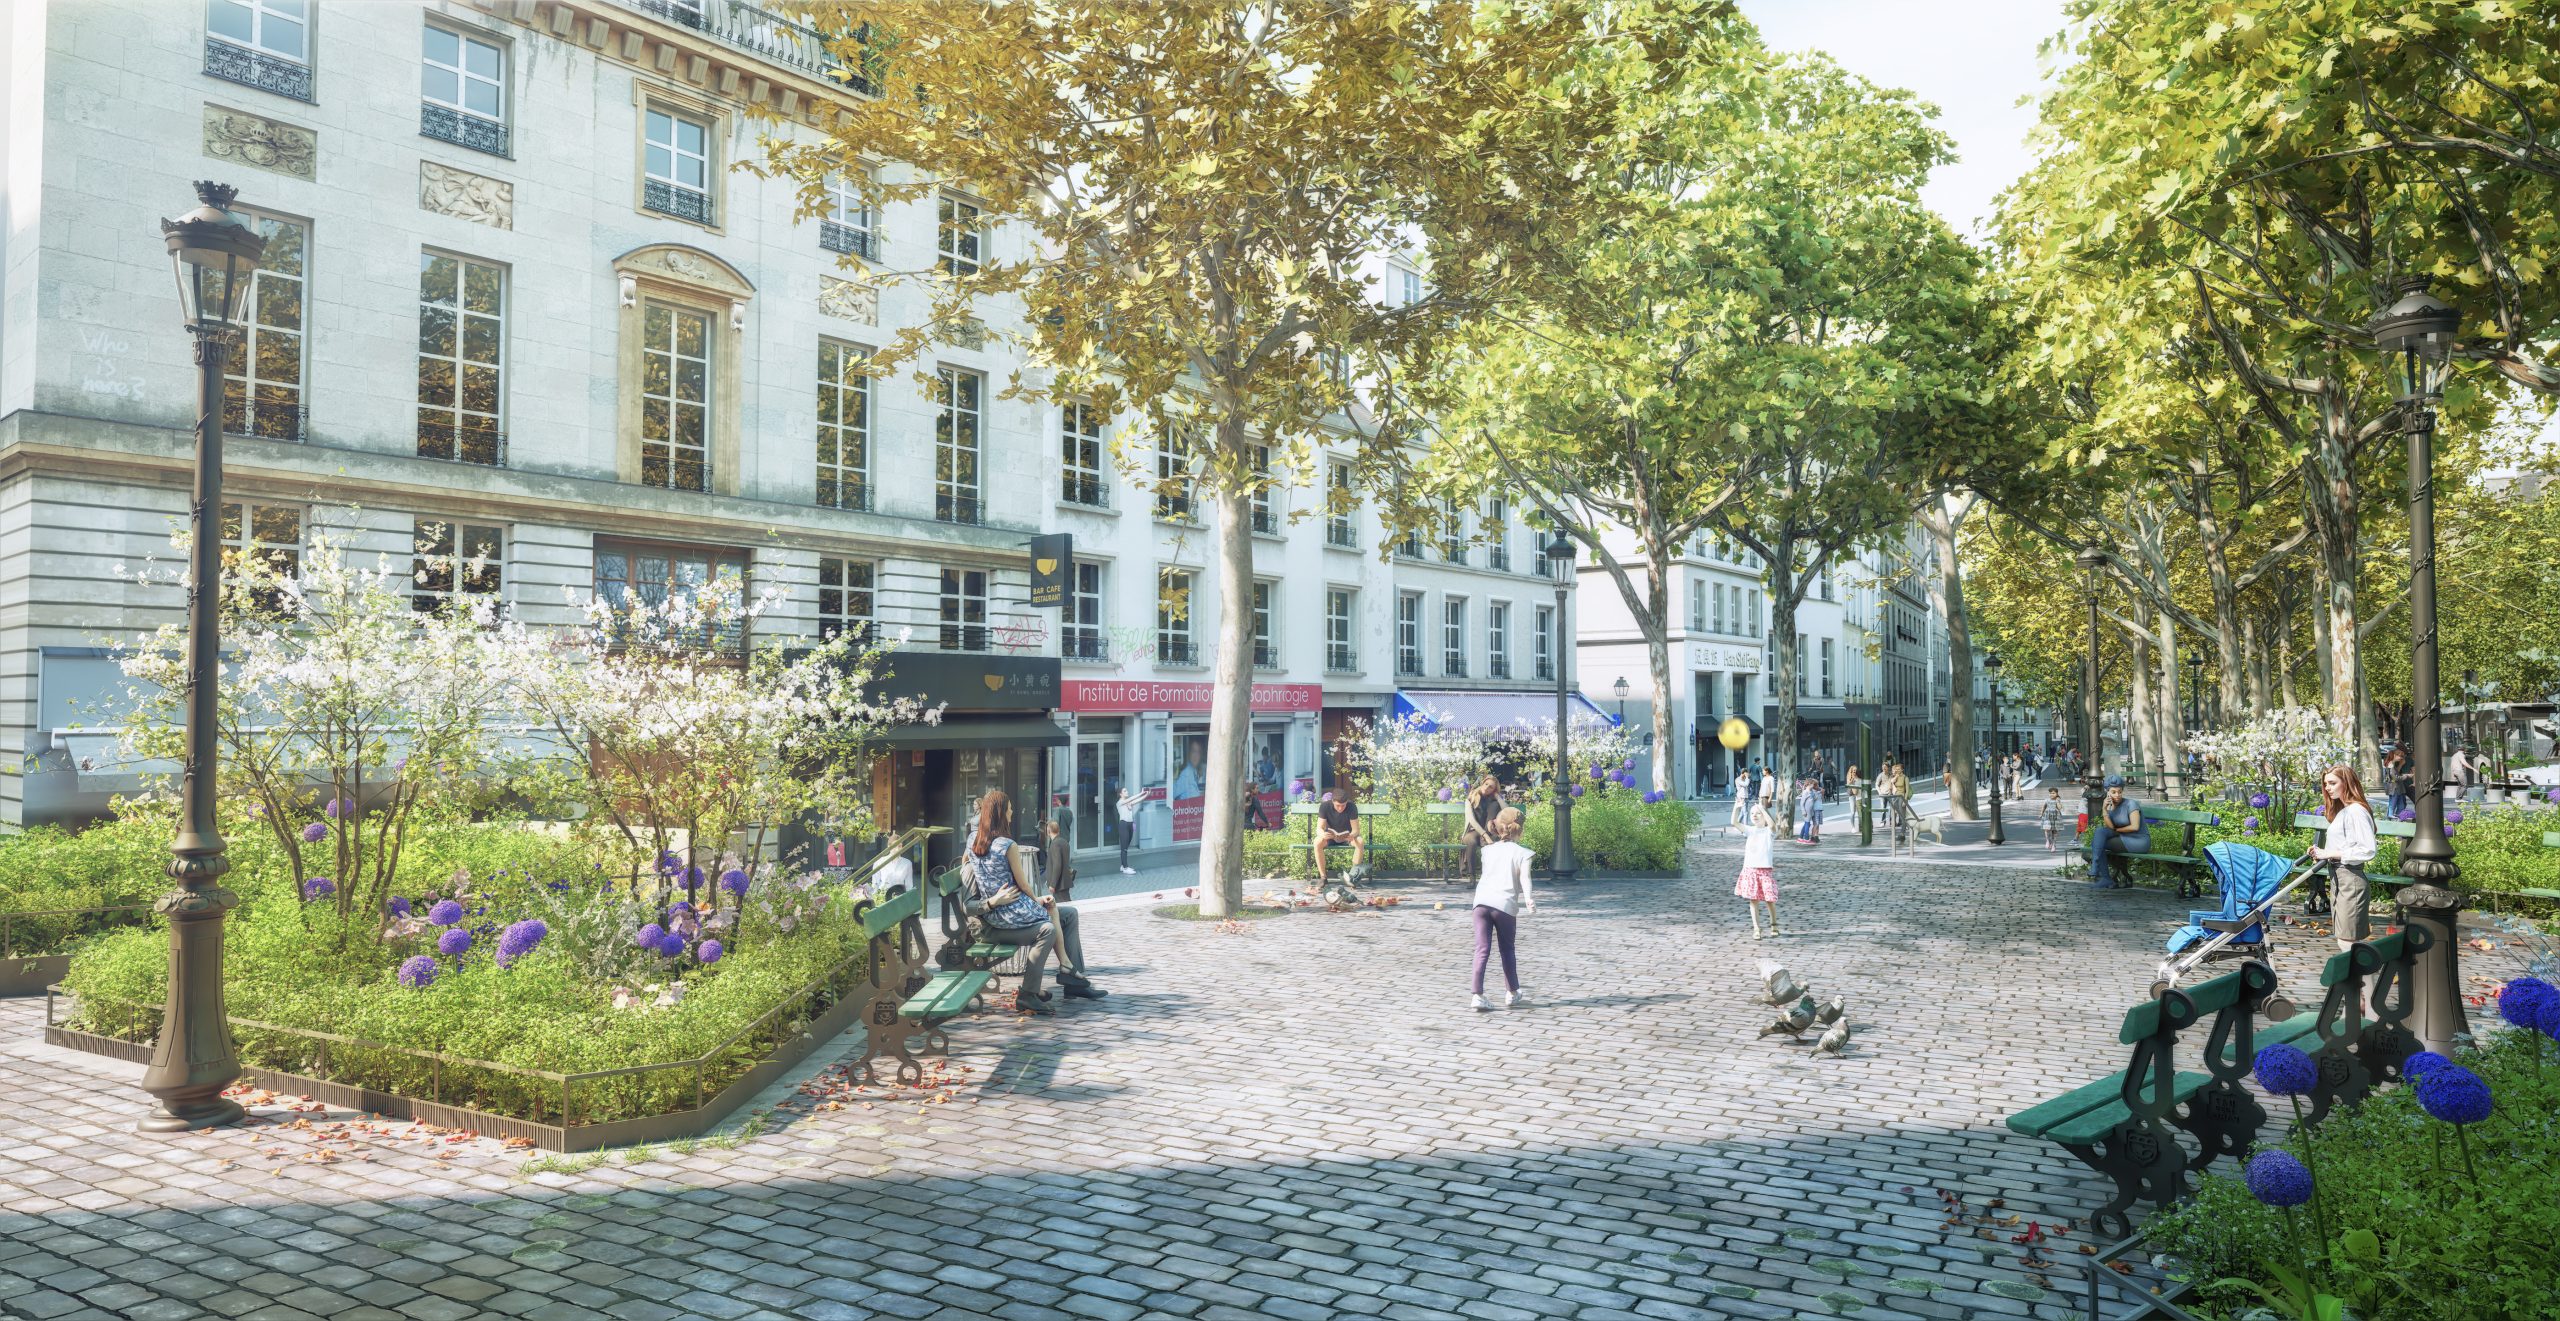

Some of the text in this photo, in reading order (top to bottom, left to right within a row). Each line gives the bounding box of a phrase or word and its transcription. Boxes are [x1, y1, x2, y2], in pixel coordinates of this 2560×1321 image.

[1032, 585, 1061, 595] BAR CAFE
[1032, 594, 1061, 603] RESTAURANT
[1078, 683, 1125, 702] Institut
[1128, 683, 1148, 702] de
